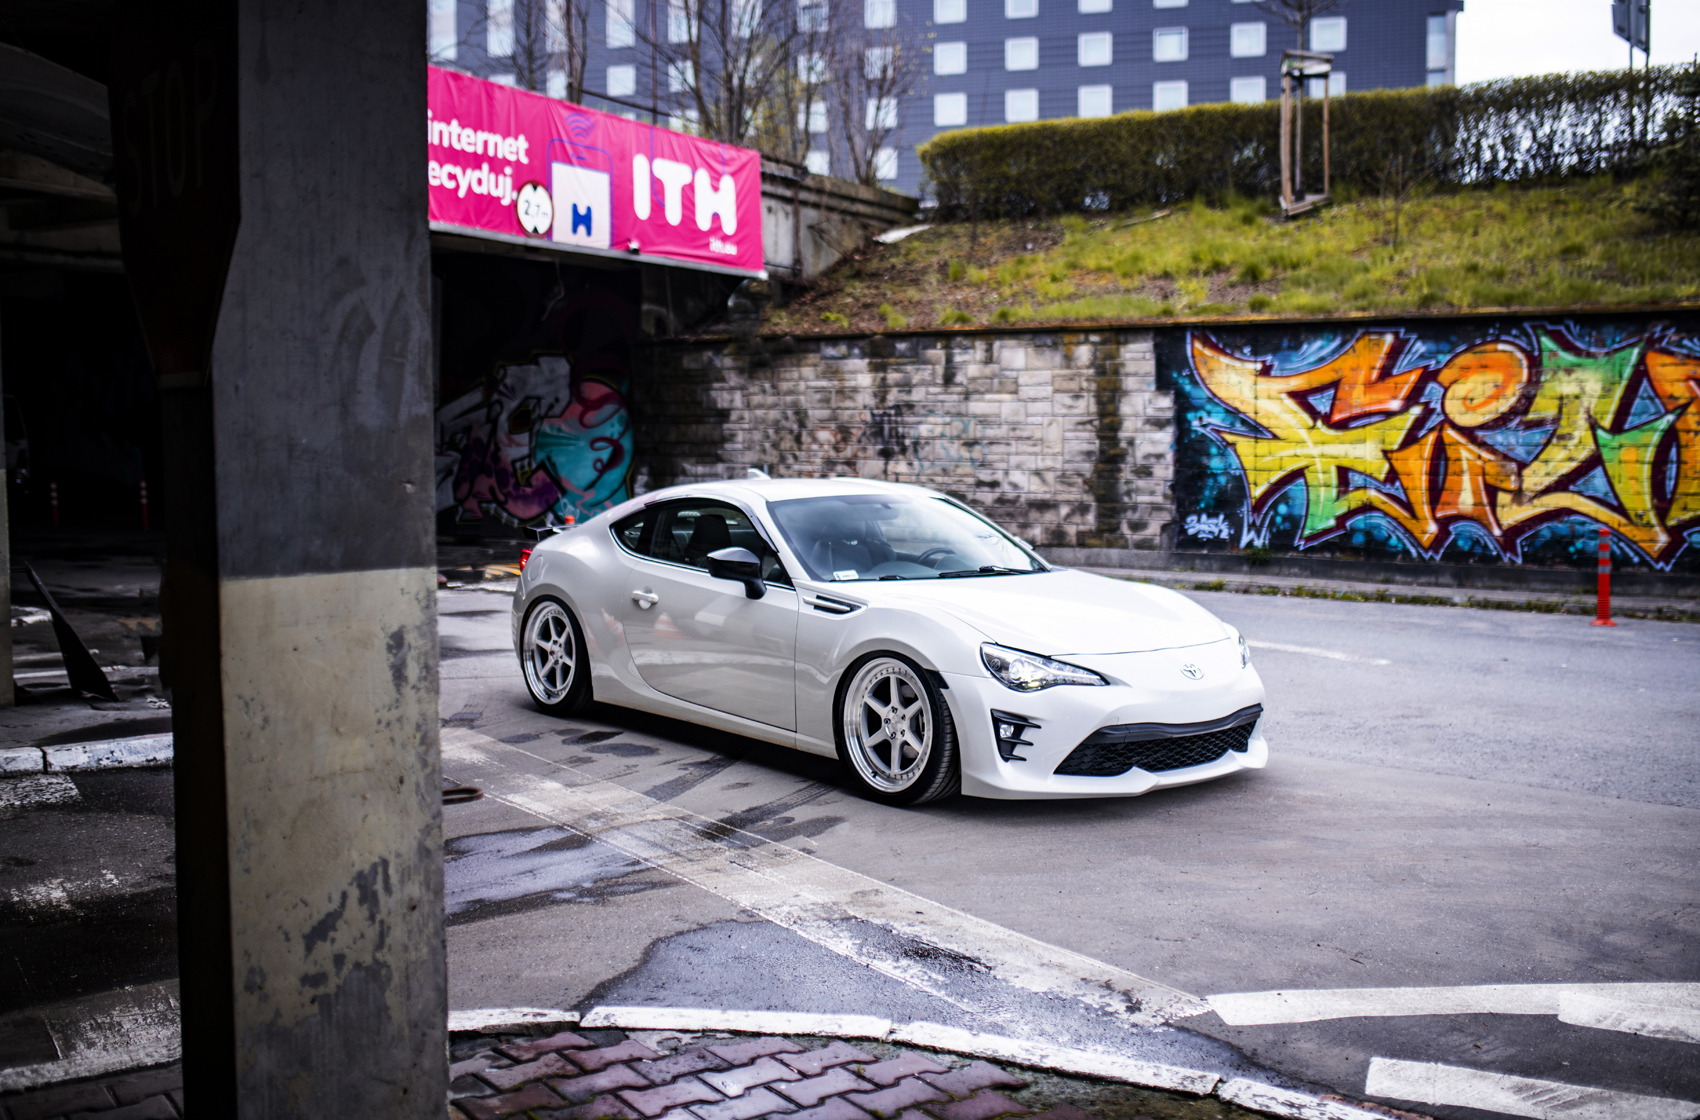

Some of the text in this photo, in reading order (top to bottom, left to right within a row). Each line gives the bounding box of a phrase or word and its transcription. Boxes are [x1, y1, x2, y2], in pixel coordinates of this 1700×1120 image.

[122, 37, 218, 220] STOP
[428, 109, 529, 165] internet
[633, 153, 738, 236] ITH
